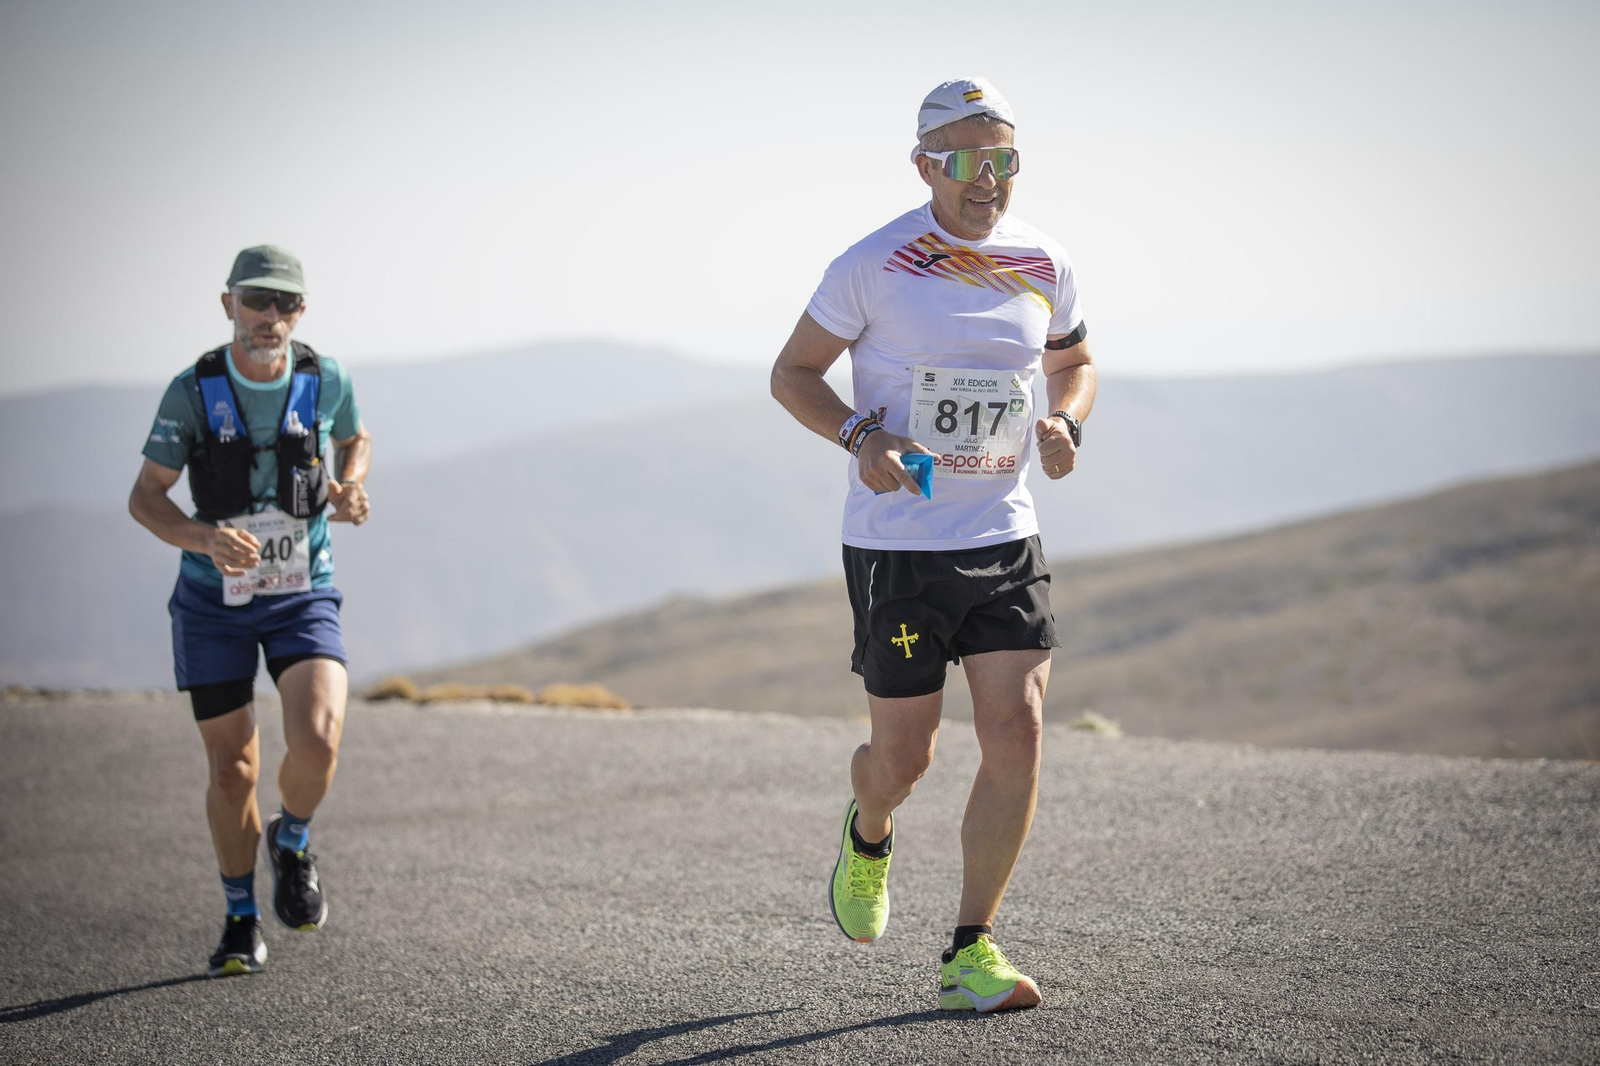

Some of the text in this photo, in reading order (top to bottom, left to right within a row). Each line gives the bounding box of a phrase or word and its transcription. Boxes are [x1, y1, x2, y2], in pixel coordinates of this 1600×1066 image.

[953, 378, 998, 388] XIX EDICIÓN
[935, 399, 1008, 436] 817
